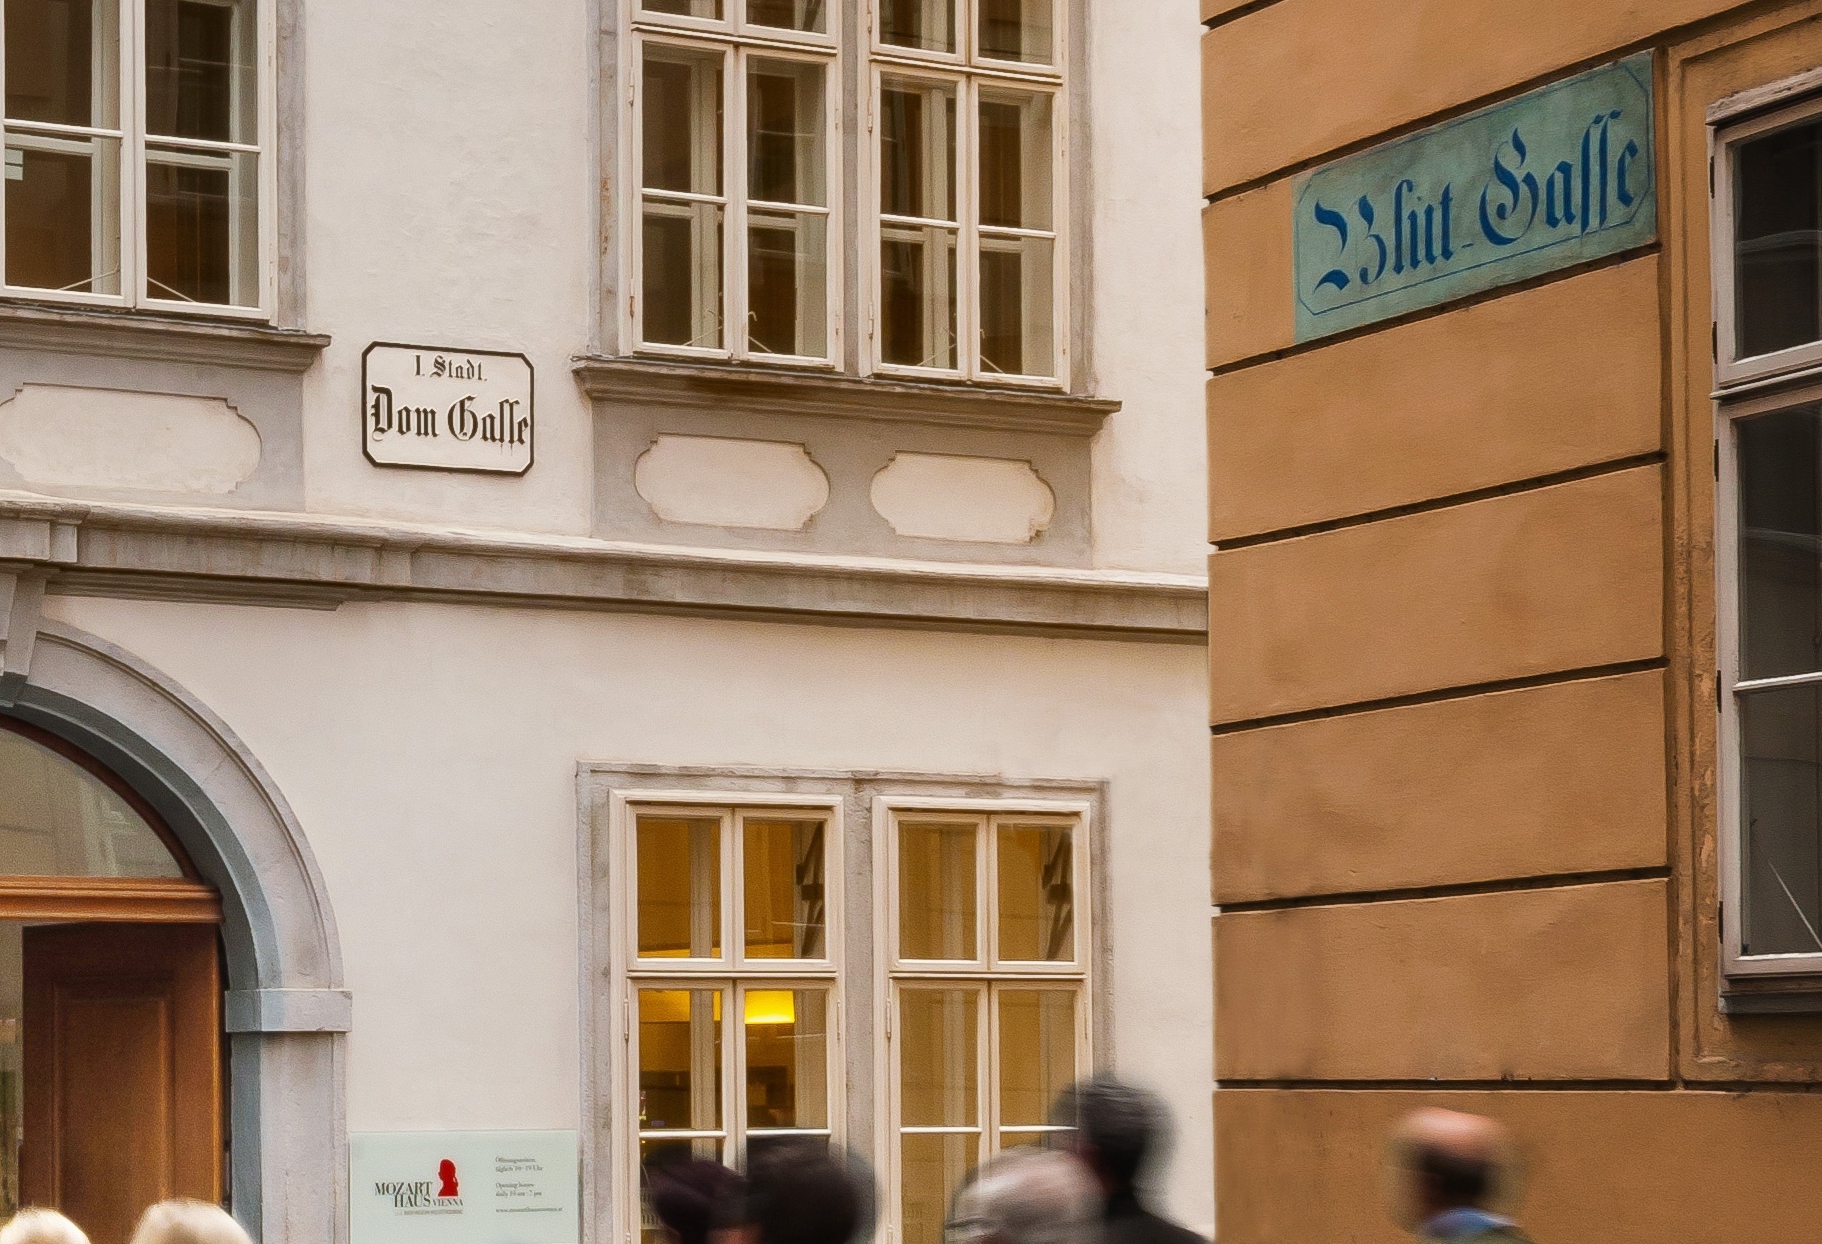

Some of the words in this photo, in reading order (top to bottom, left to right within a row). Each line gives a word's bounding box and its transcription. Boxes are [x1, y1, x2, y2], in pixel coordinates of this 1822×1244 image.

[371, 384, 440, 442] Dom
[374, 1181, 434, 1196] MOZART
[394, 1194, 432, 1208] HAUS
[432, 1198, 464, 1207] VIENNA
